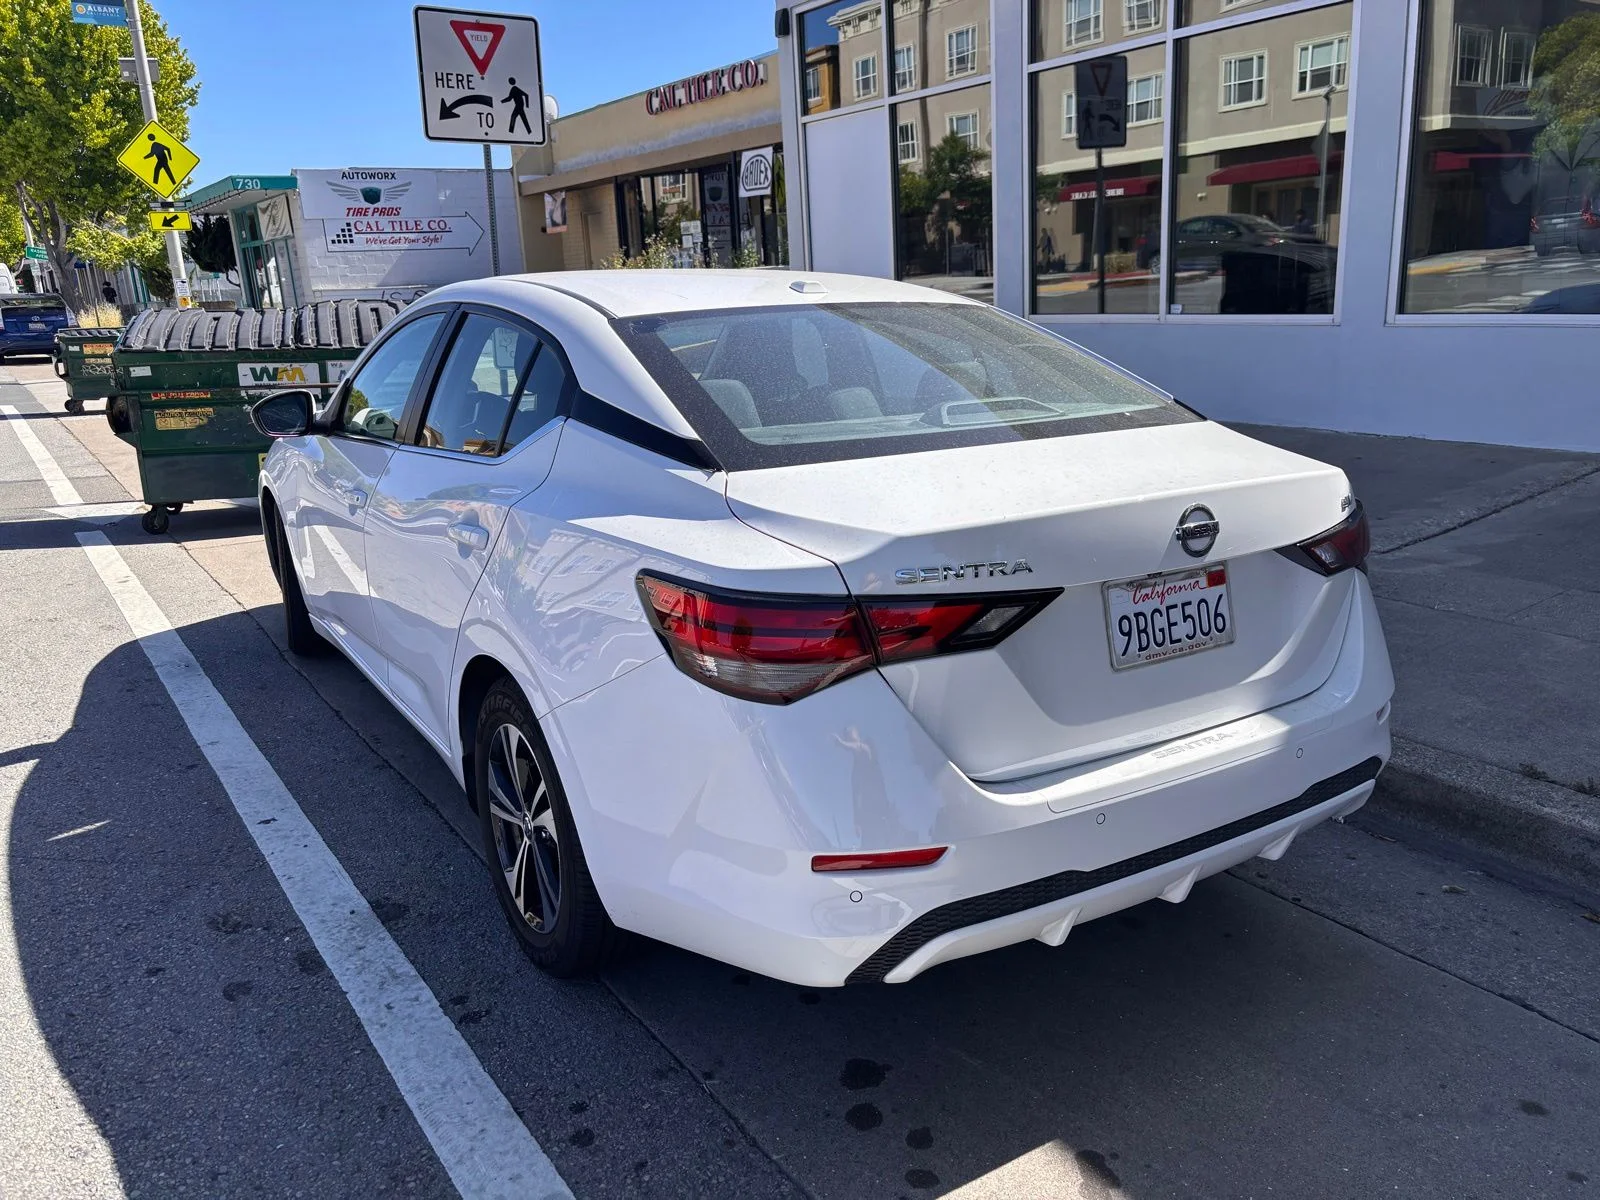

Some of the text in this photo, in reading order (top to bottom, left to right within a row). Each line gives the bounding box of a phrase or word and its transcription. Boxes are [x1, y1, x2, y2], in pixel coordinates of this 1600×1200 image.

[87, 5, 120, 13] ALBANY
[470, 34, 488, 42] YIELD
[435, 72, 475, 90] HERE
[477, 112, 494, 128] TO
[341, 172, 396, 180] AUTOWORX
[744, 159, 769, 187] ARDEX
[236, 179, 260, 189] 730
[346, 207, 401, 217] TIRE PROS
[354, 219, 452, 232] CAL TILE CO.
[365, 235, 443, 246] We've Got Your Style!
[250, 367, 306, 382] WM
[1182, 522, 1218, 539] NISSAN
[895, 559, 1033, 585] SENTRA
[1132, 580, 1206, 605] California
[1118, 594, 1226, 657] 9BGE506
[1145, 640, 1208, 660] dmv.ca.gov
[1151, 732, 1233, 759] SENTRA
